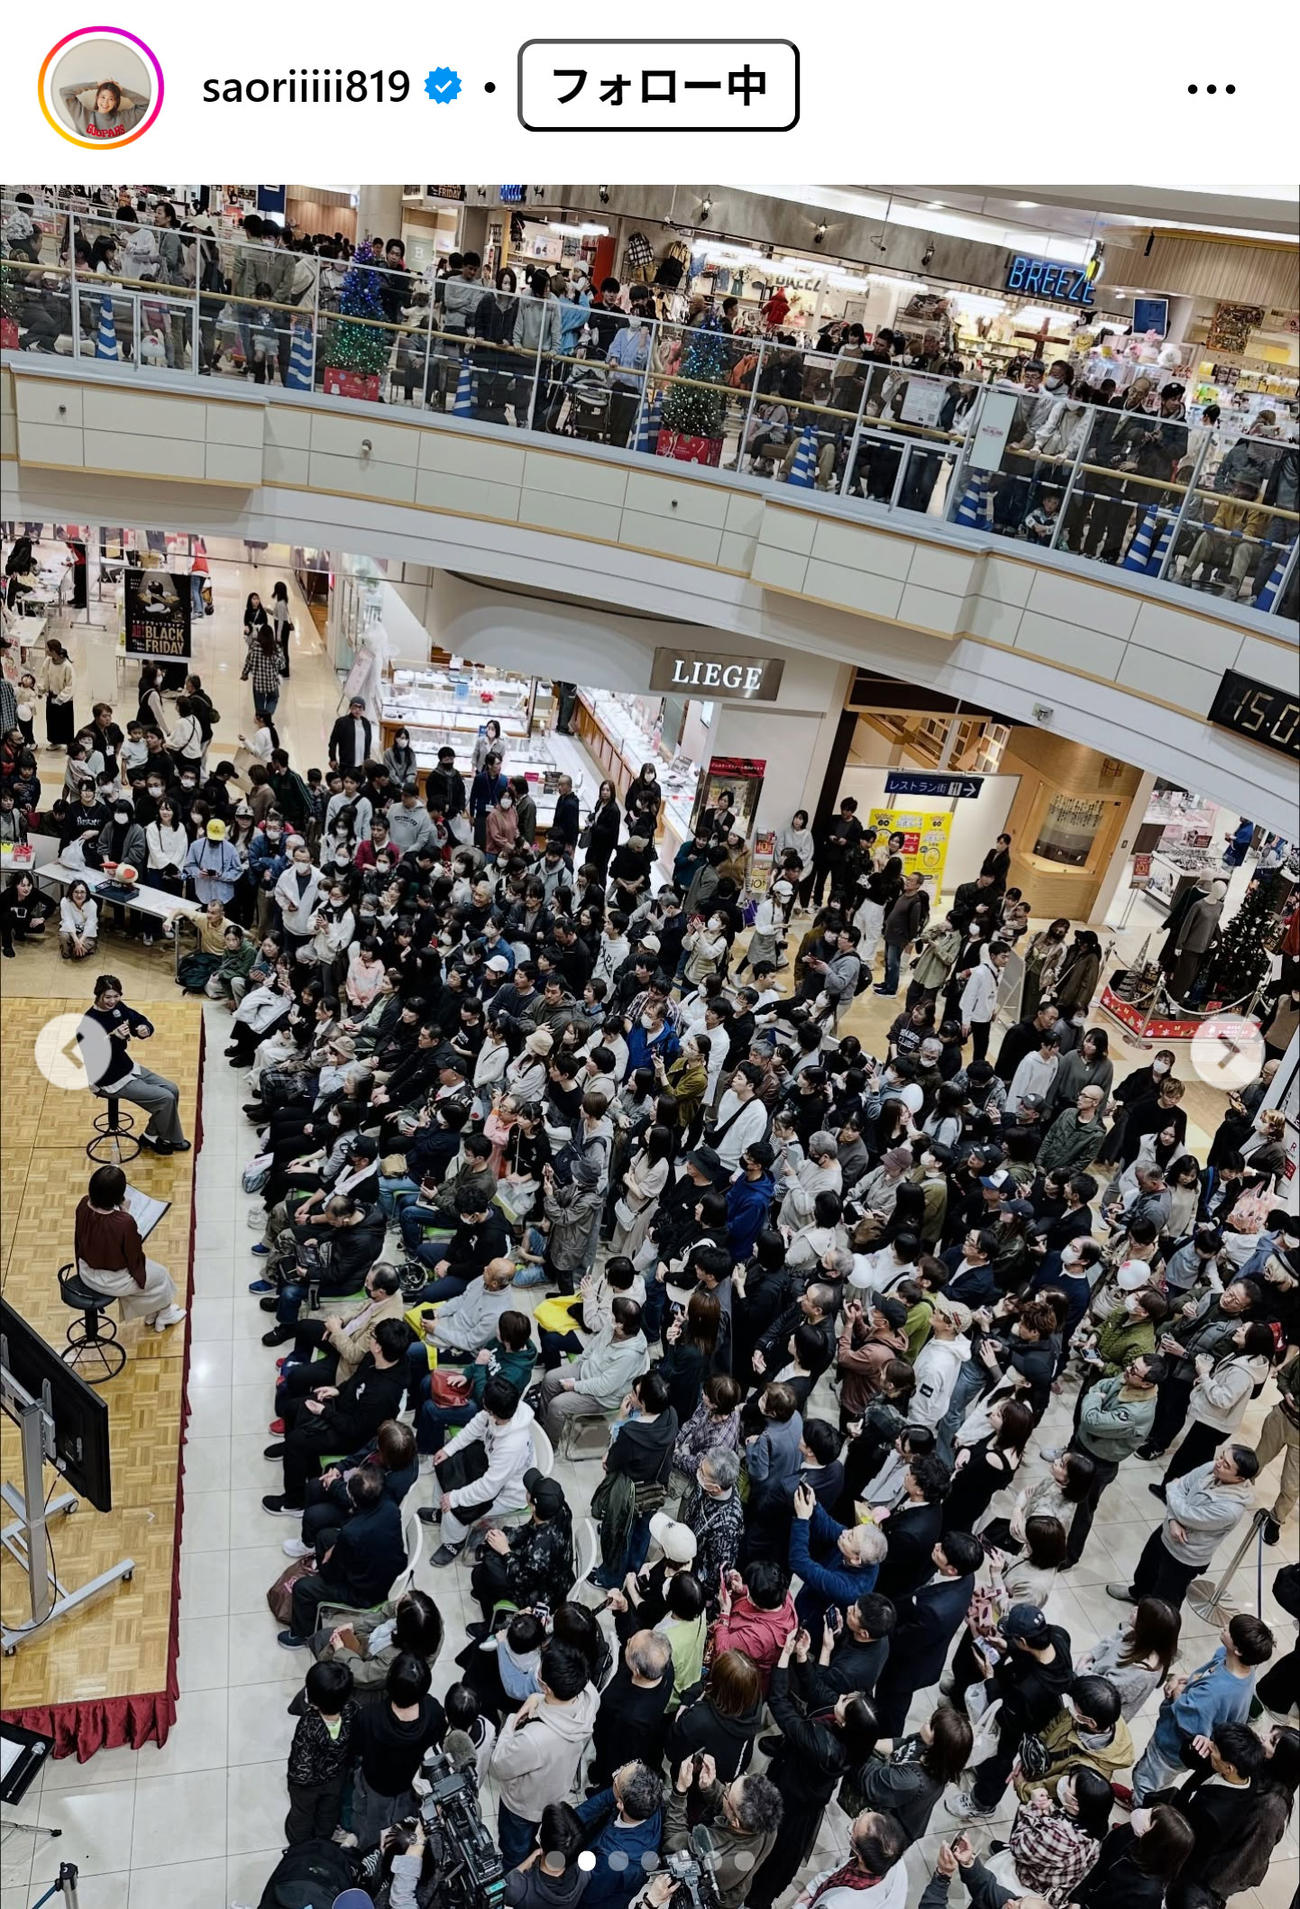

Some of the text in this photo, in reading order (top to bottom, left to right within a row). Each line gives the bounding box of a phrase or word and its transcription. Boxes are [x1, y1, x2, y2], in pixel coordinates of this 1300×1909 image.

[1008, 257, 1095, 303] BREEZE
[145, 625, 184, 641] BLACK
[145, 639, 184, 655] FRIDAY
[672, 660, 762, 690] LIEGE
[889, 781, 947, 793] レストラン街
